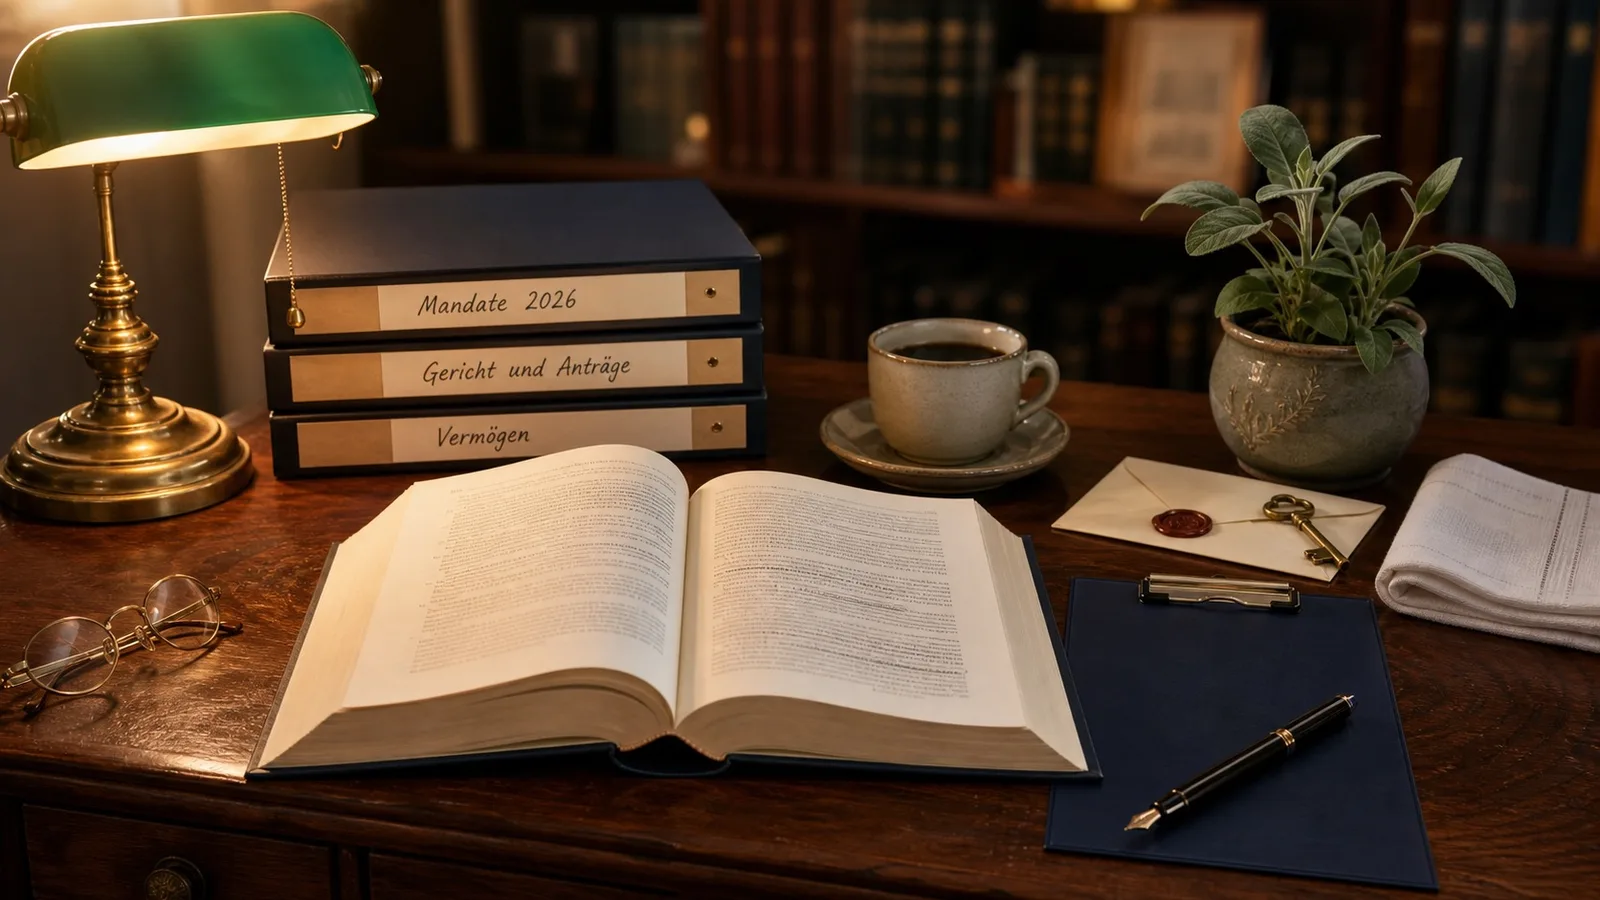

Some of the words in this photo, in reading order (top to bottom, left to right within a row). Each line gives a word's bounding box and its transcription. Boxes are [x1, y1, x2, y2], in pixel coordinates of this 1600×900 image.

[417, 293, 508, 316] Mandate
[524, 289, 577, 310] 2026
[422, 360, 497, 386] Gericht
[508, 357, 547, 378] und
[556, 355, 631, 382] Anträge
[438, 425, 530, 452] Vermögen
